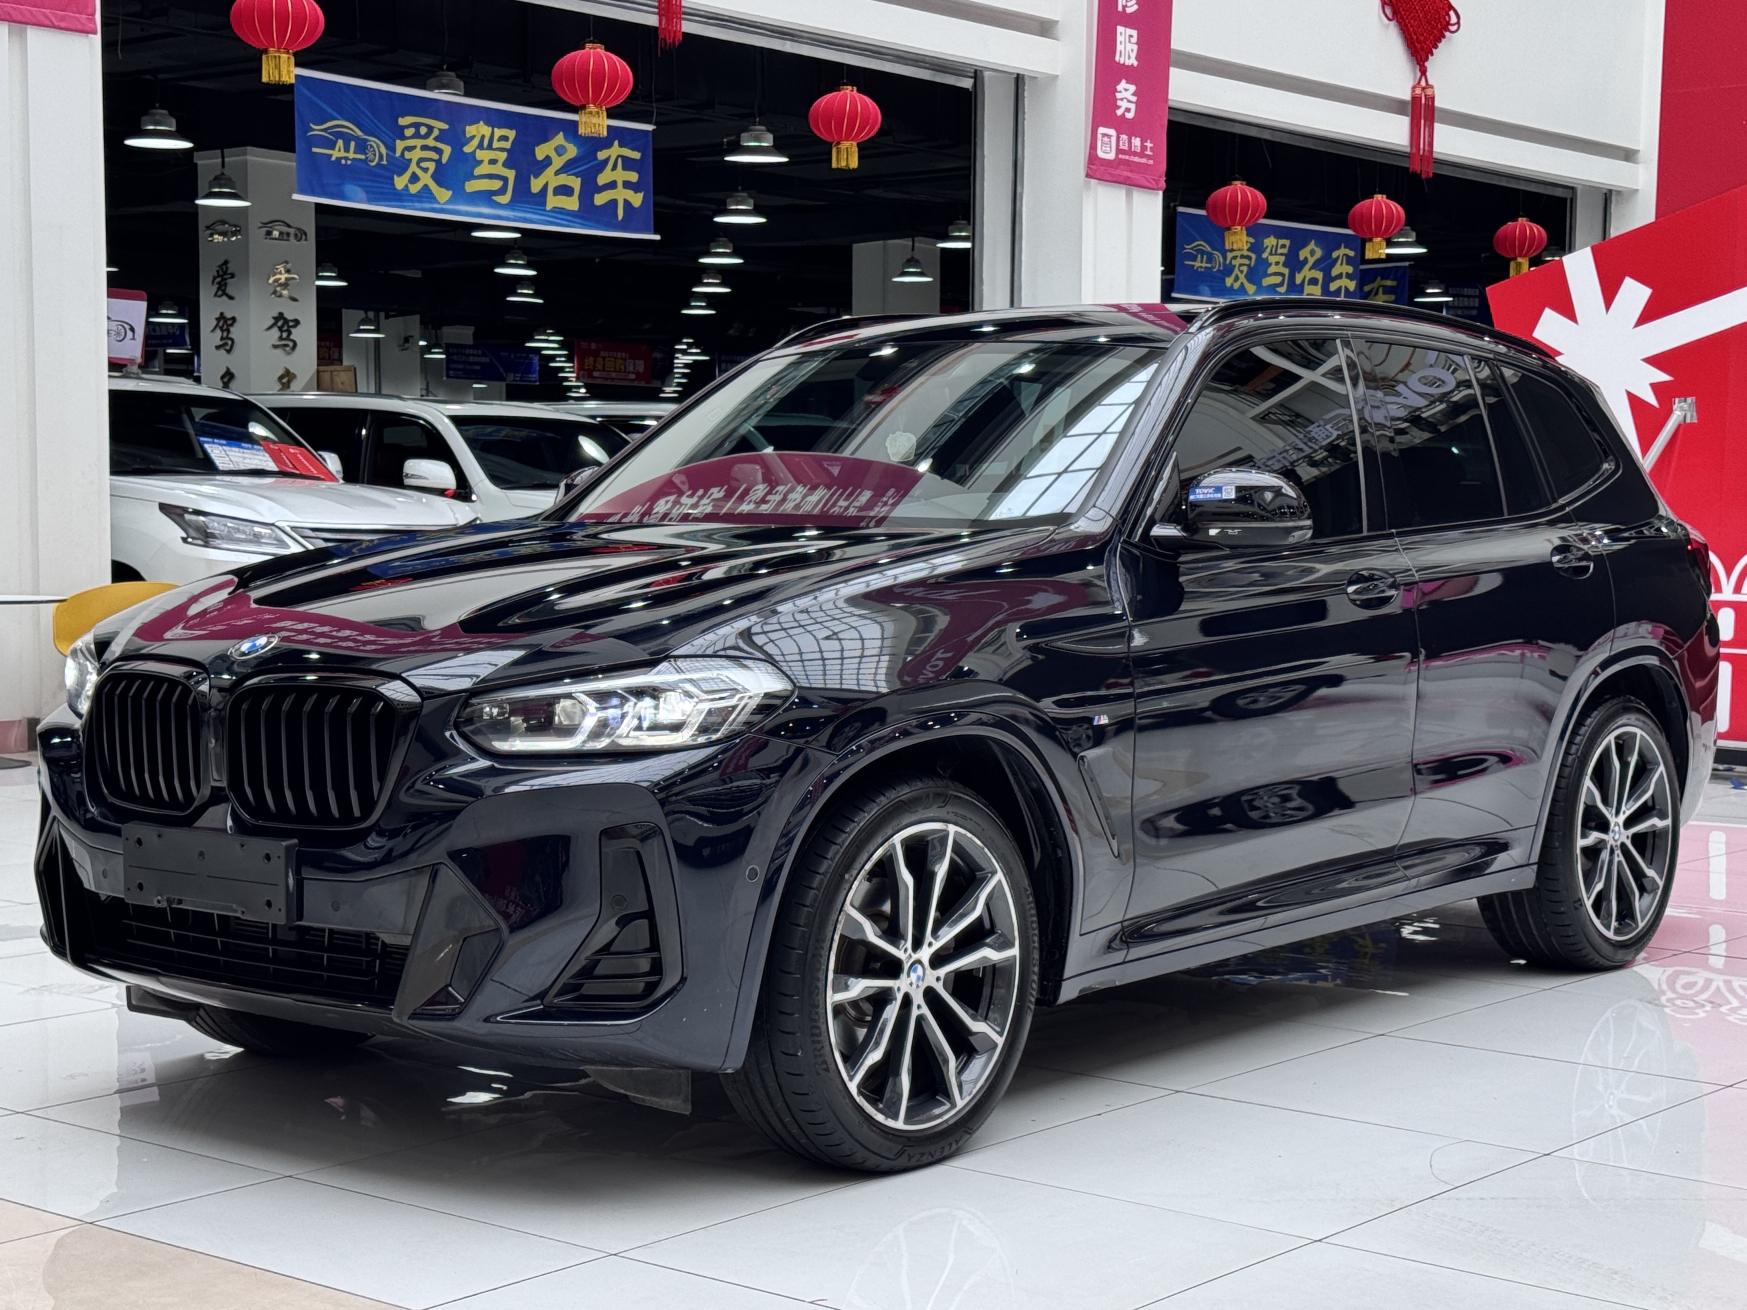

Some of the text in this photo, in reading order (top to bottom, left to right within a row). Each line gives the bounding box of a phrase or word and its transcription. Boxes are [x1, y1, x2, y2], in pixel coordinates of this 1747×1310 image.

[394, 116, 644, 221] 爱驾名车
[1225, 235, 1357, 299] 爱驾名车
